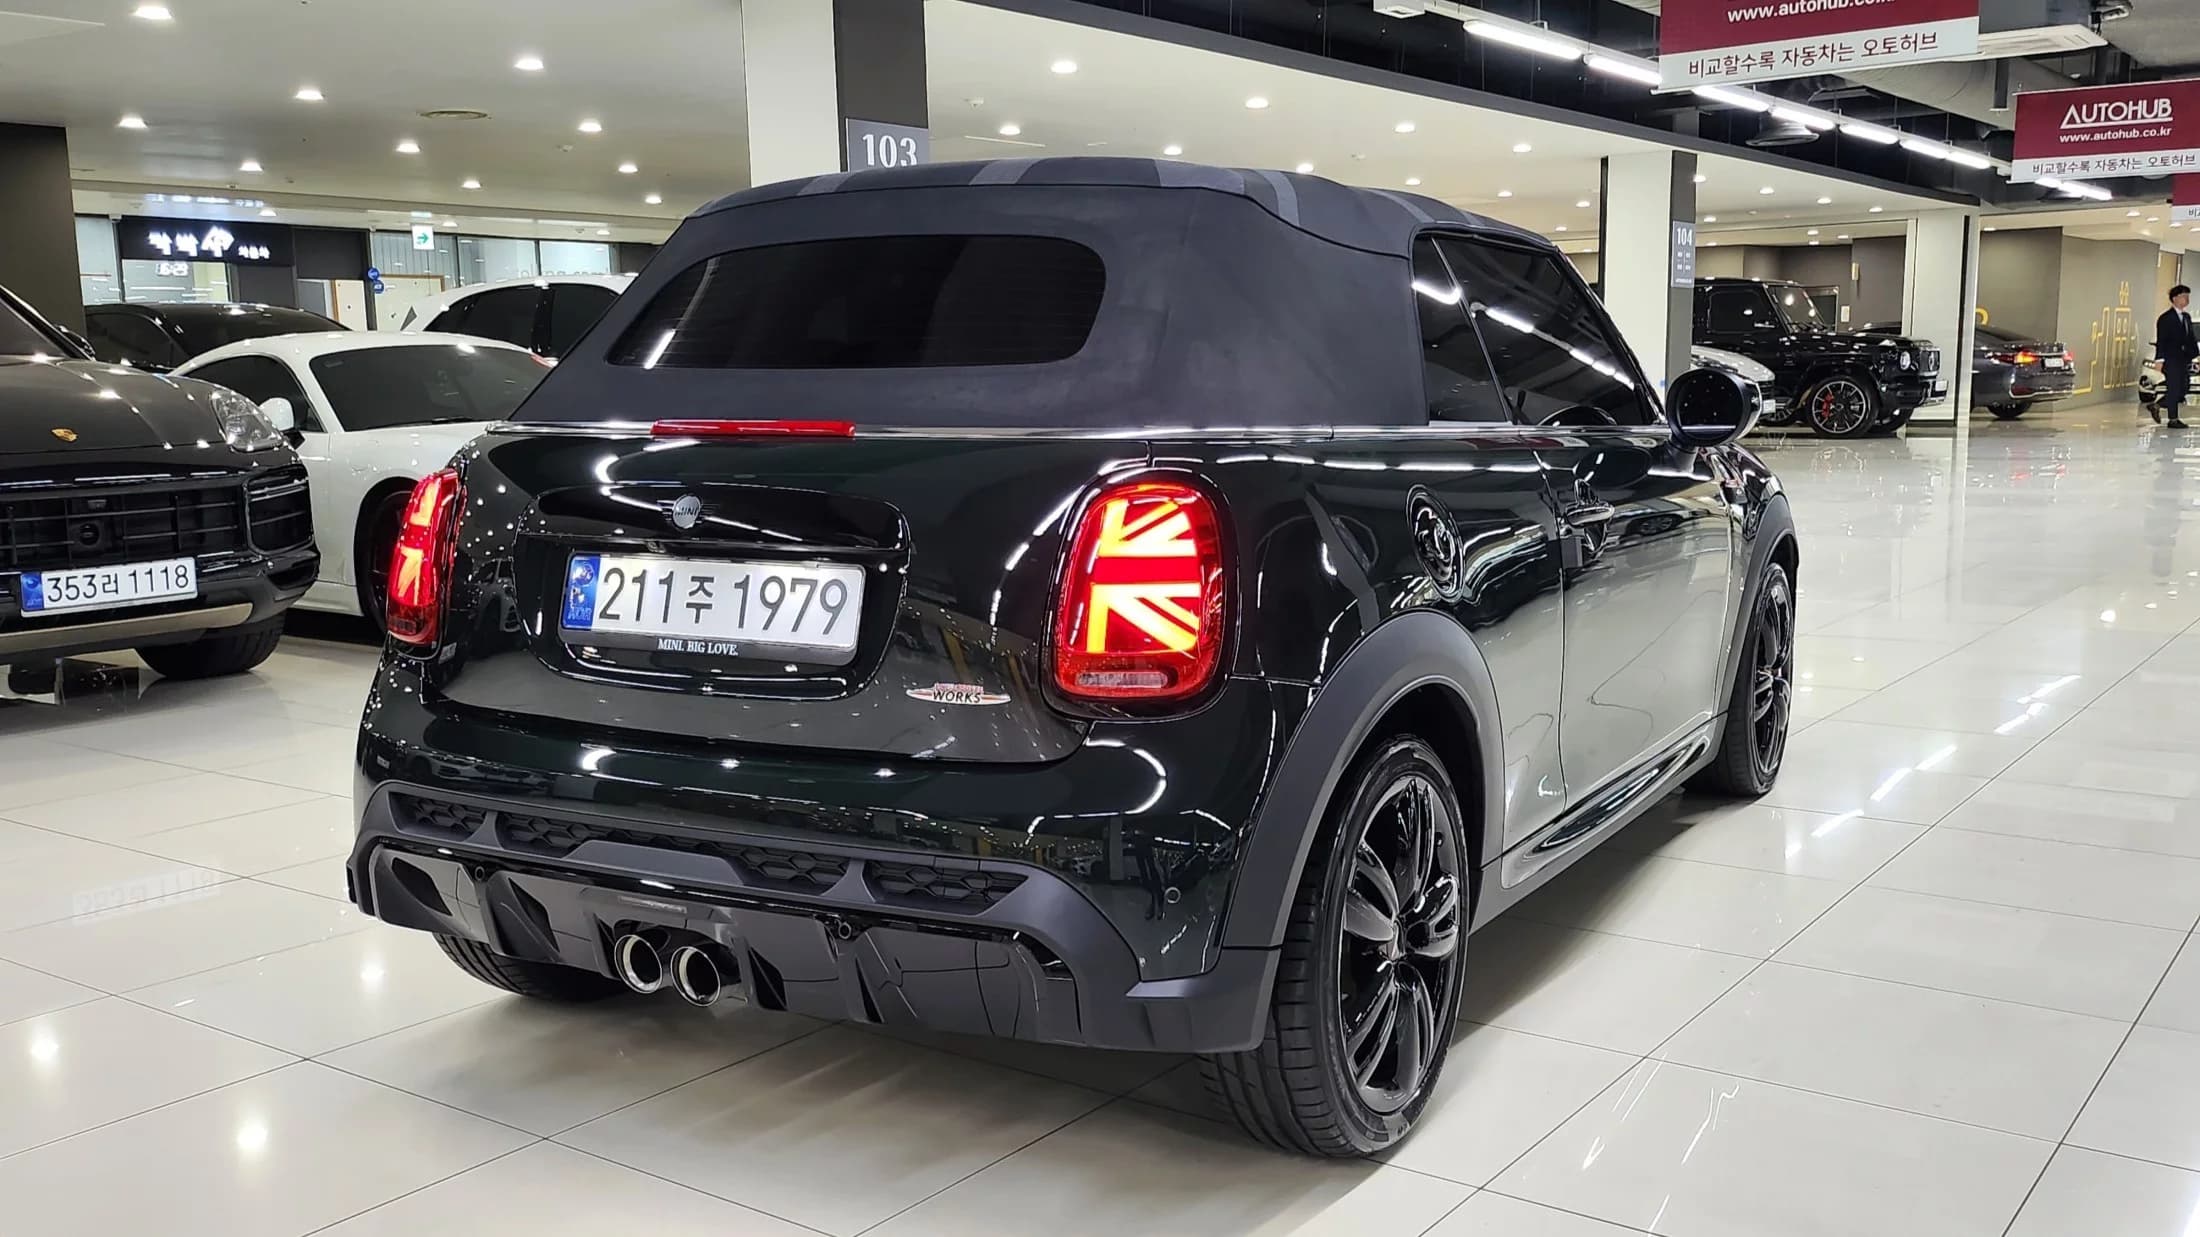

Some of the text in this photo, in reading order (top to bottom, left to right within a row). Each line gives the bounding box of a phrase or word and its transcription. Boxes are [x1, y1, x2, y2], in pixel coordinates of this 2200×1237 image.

[1689, 32, 1938, 78] 비교할수록 자동차는 오토허브
[2060, 98, 2173, 129] AUTOHUB
[2060, 126, 2172, 143] www.autohub.co.kr
[862, 133, 918, 168] 103
[2033, 154, 2197, 175] 비교할수록 자동차는 오토허브
[1677, 227, 1693, 246] 104
[47, 564, 189, 602] 353러 1118
[599, 567, 848, 635] 211주 1979
[657, 638, 739, 656] MINI. BIG LOVE.
[933, 690, 981, 703] WORKS
